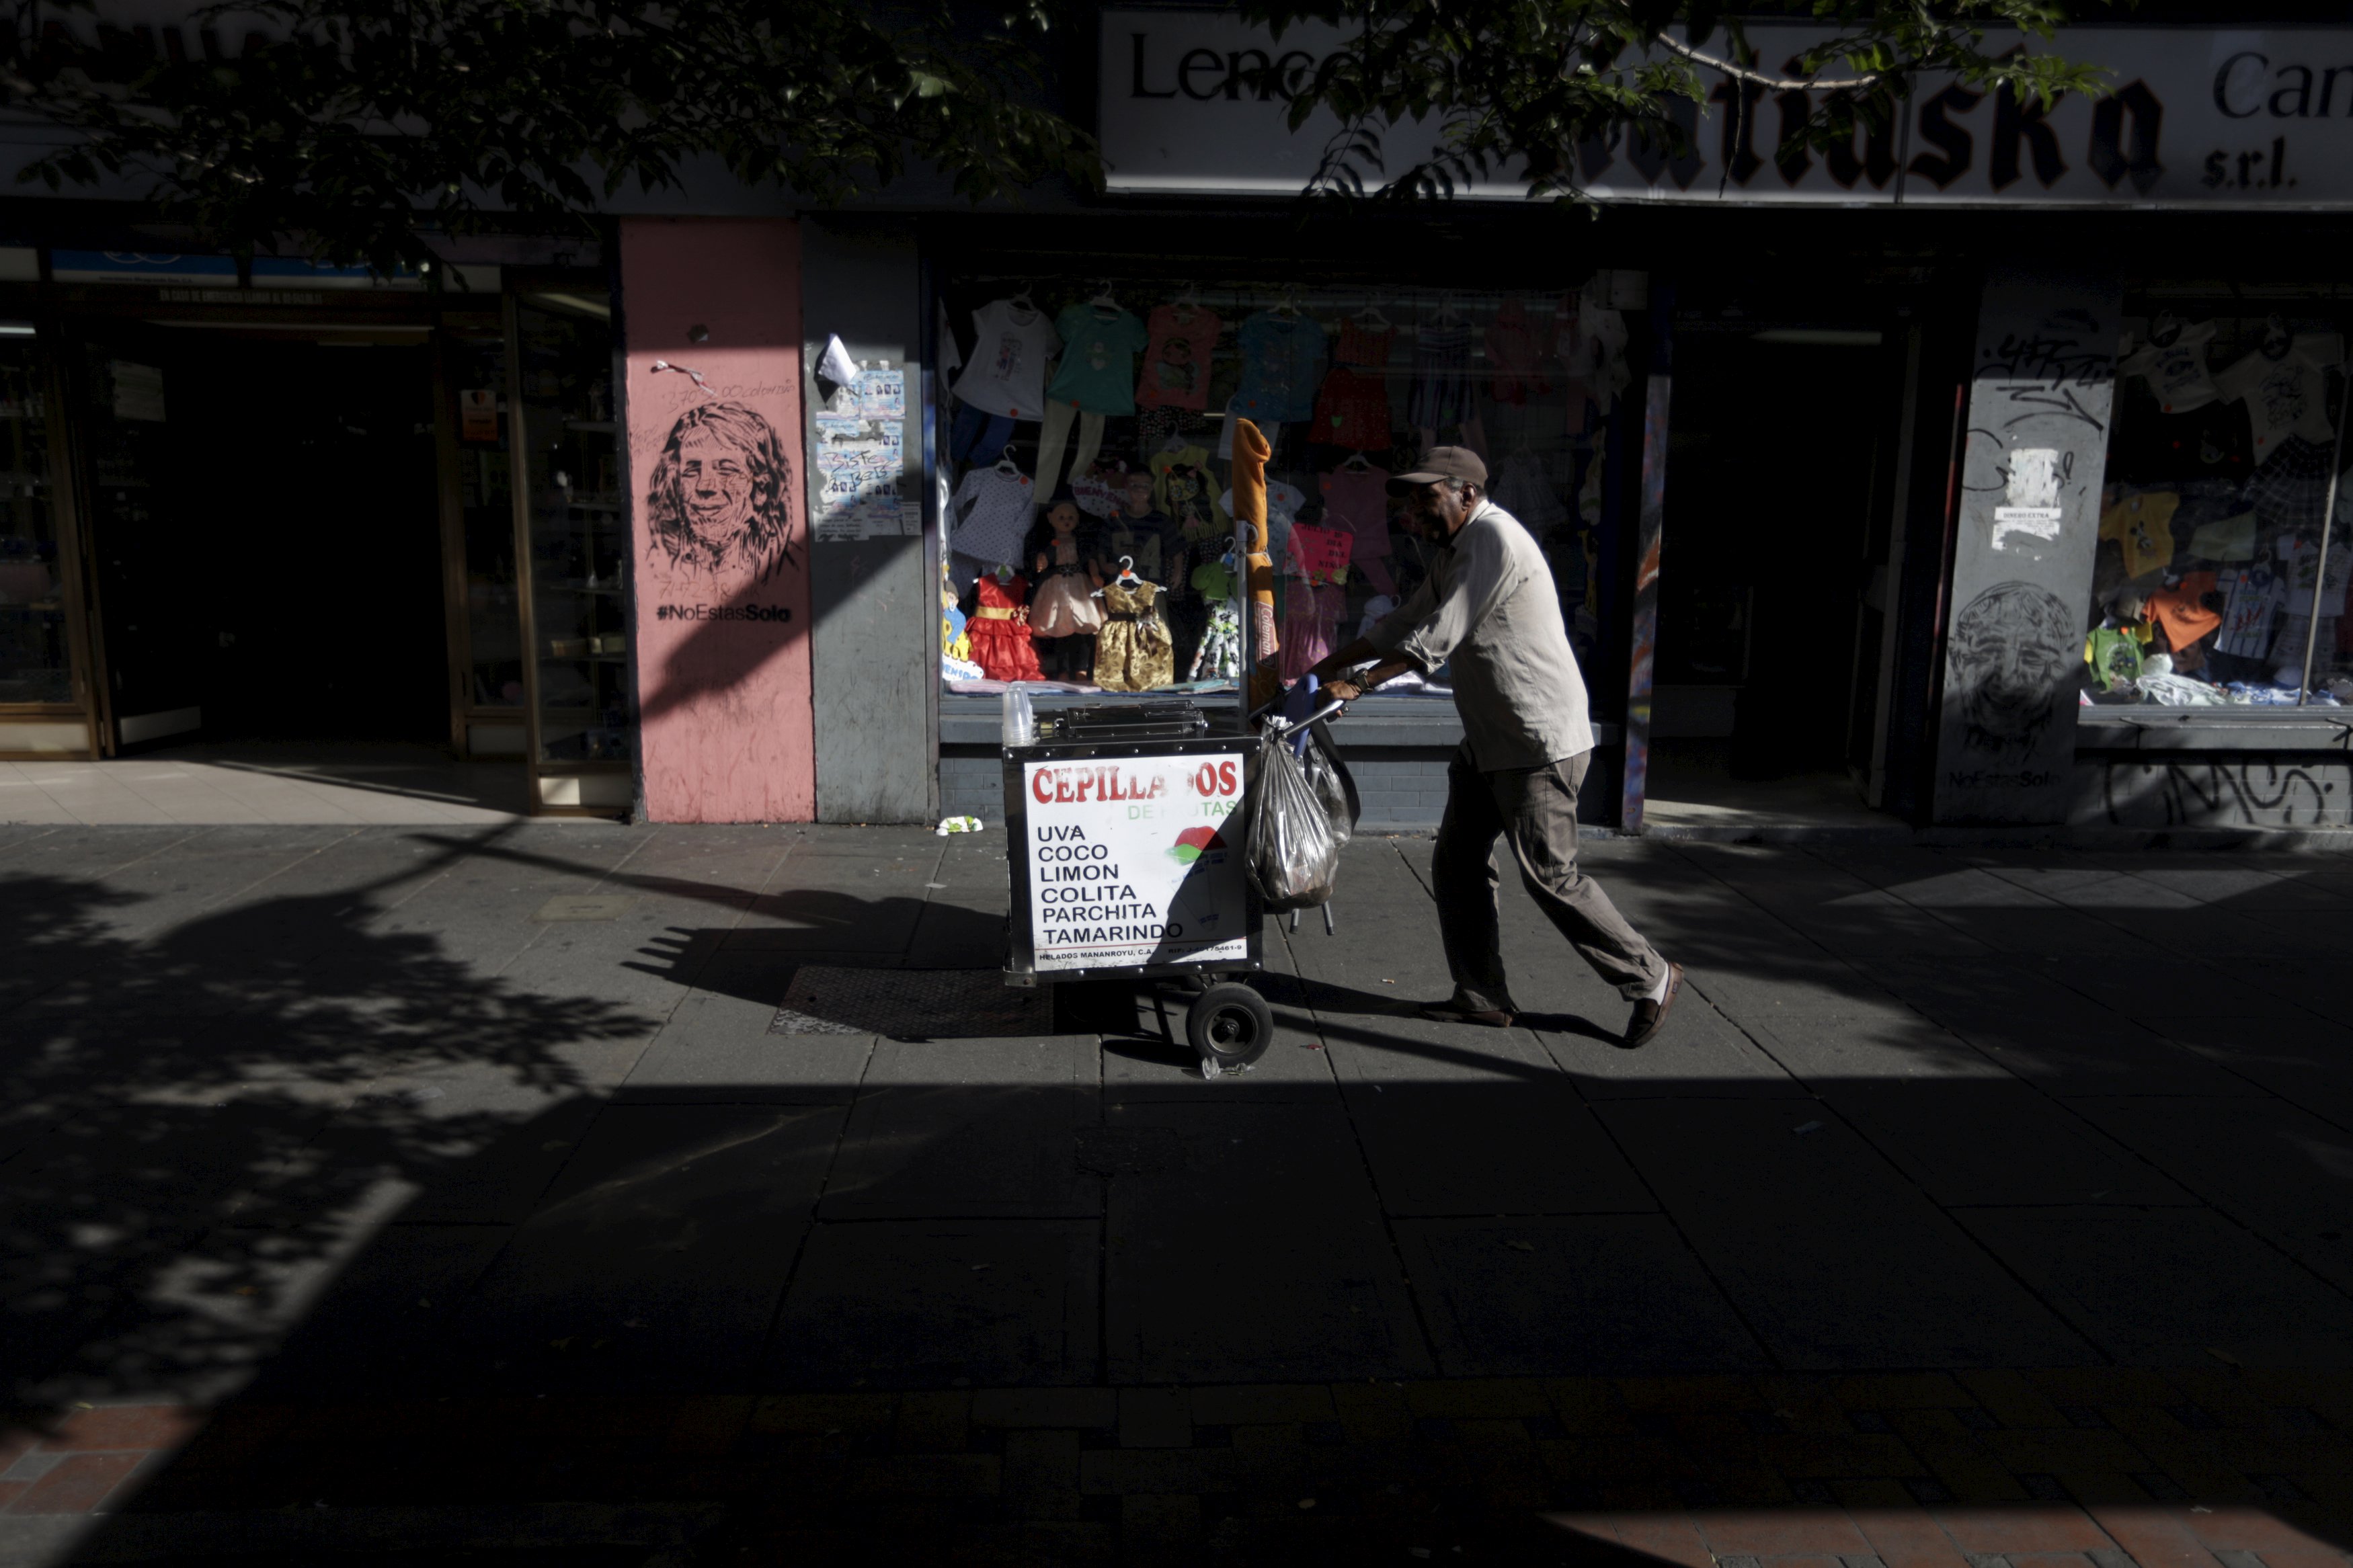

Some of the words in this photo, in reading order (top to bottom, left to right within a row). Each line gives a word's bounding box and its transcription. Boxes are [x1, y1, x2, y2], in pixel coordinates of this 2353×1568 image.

[2200, 135, 2298, 189] s.r.l.
[657, 604, 792, 622] #NoEstasSolo
[1261, 608, 1273, 655] Coleman
[1037, 825, 1086, 842] UVA
[1038, 844, 1109, 862] COCO
[1040, 864, 1119, 882] LIMON
[1041, 884, 1137, 903] COLITA
[1043, 903, 1157, 923] PARCHITA
[1043, 922, 1183, 944] TAMARINDO
[1039, 952, 1078, 960] HELADOS
